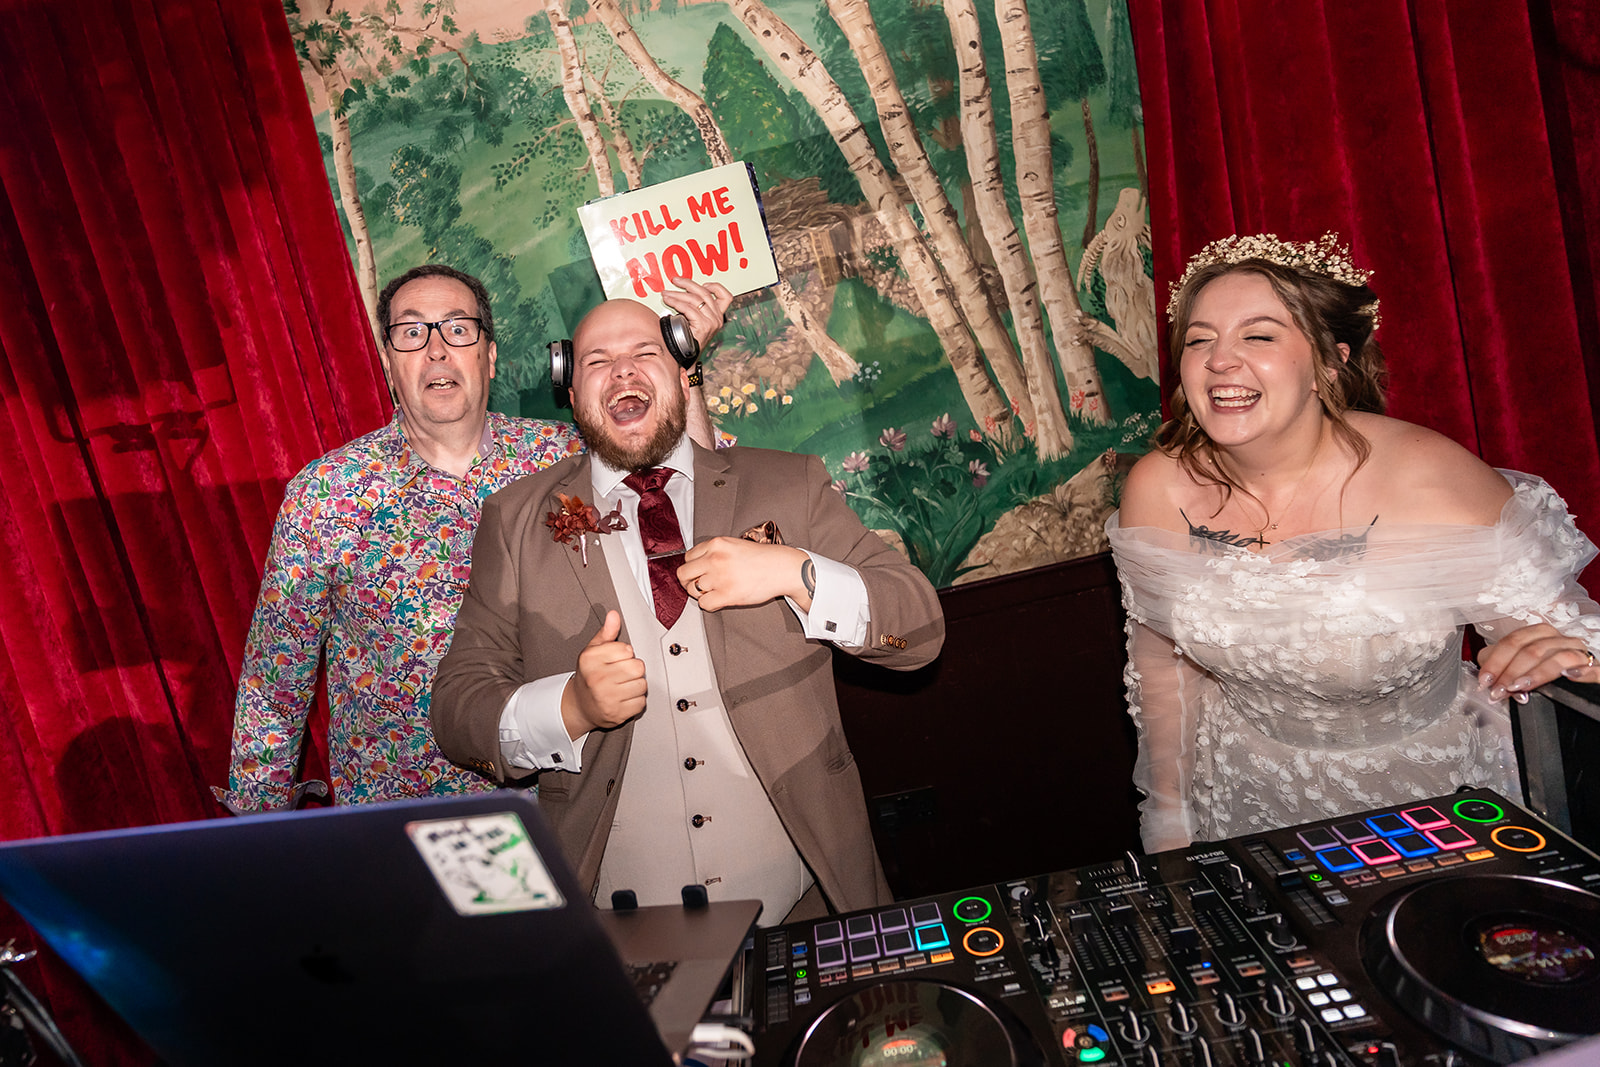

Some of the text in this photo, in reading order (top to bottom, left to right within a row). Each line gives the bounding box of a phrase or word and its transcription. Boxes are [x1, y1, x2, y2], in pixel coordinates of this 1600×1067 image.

[609, 186, 735, 246] KILL ME
[625, 221, 748, 298] NOW!
